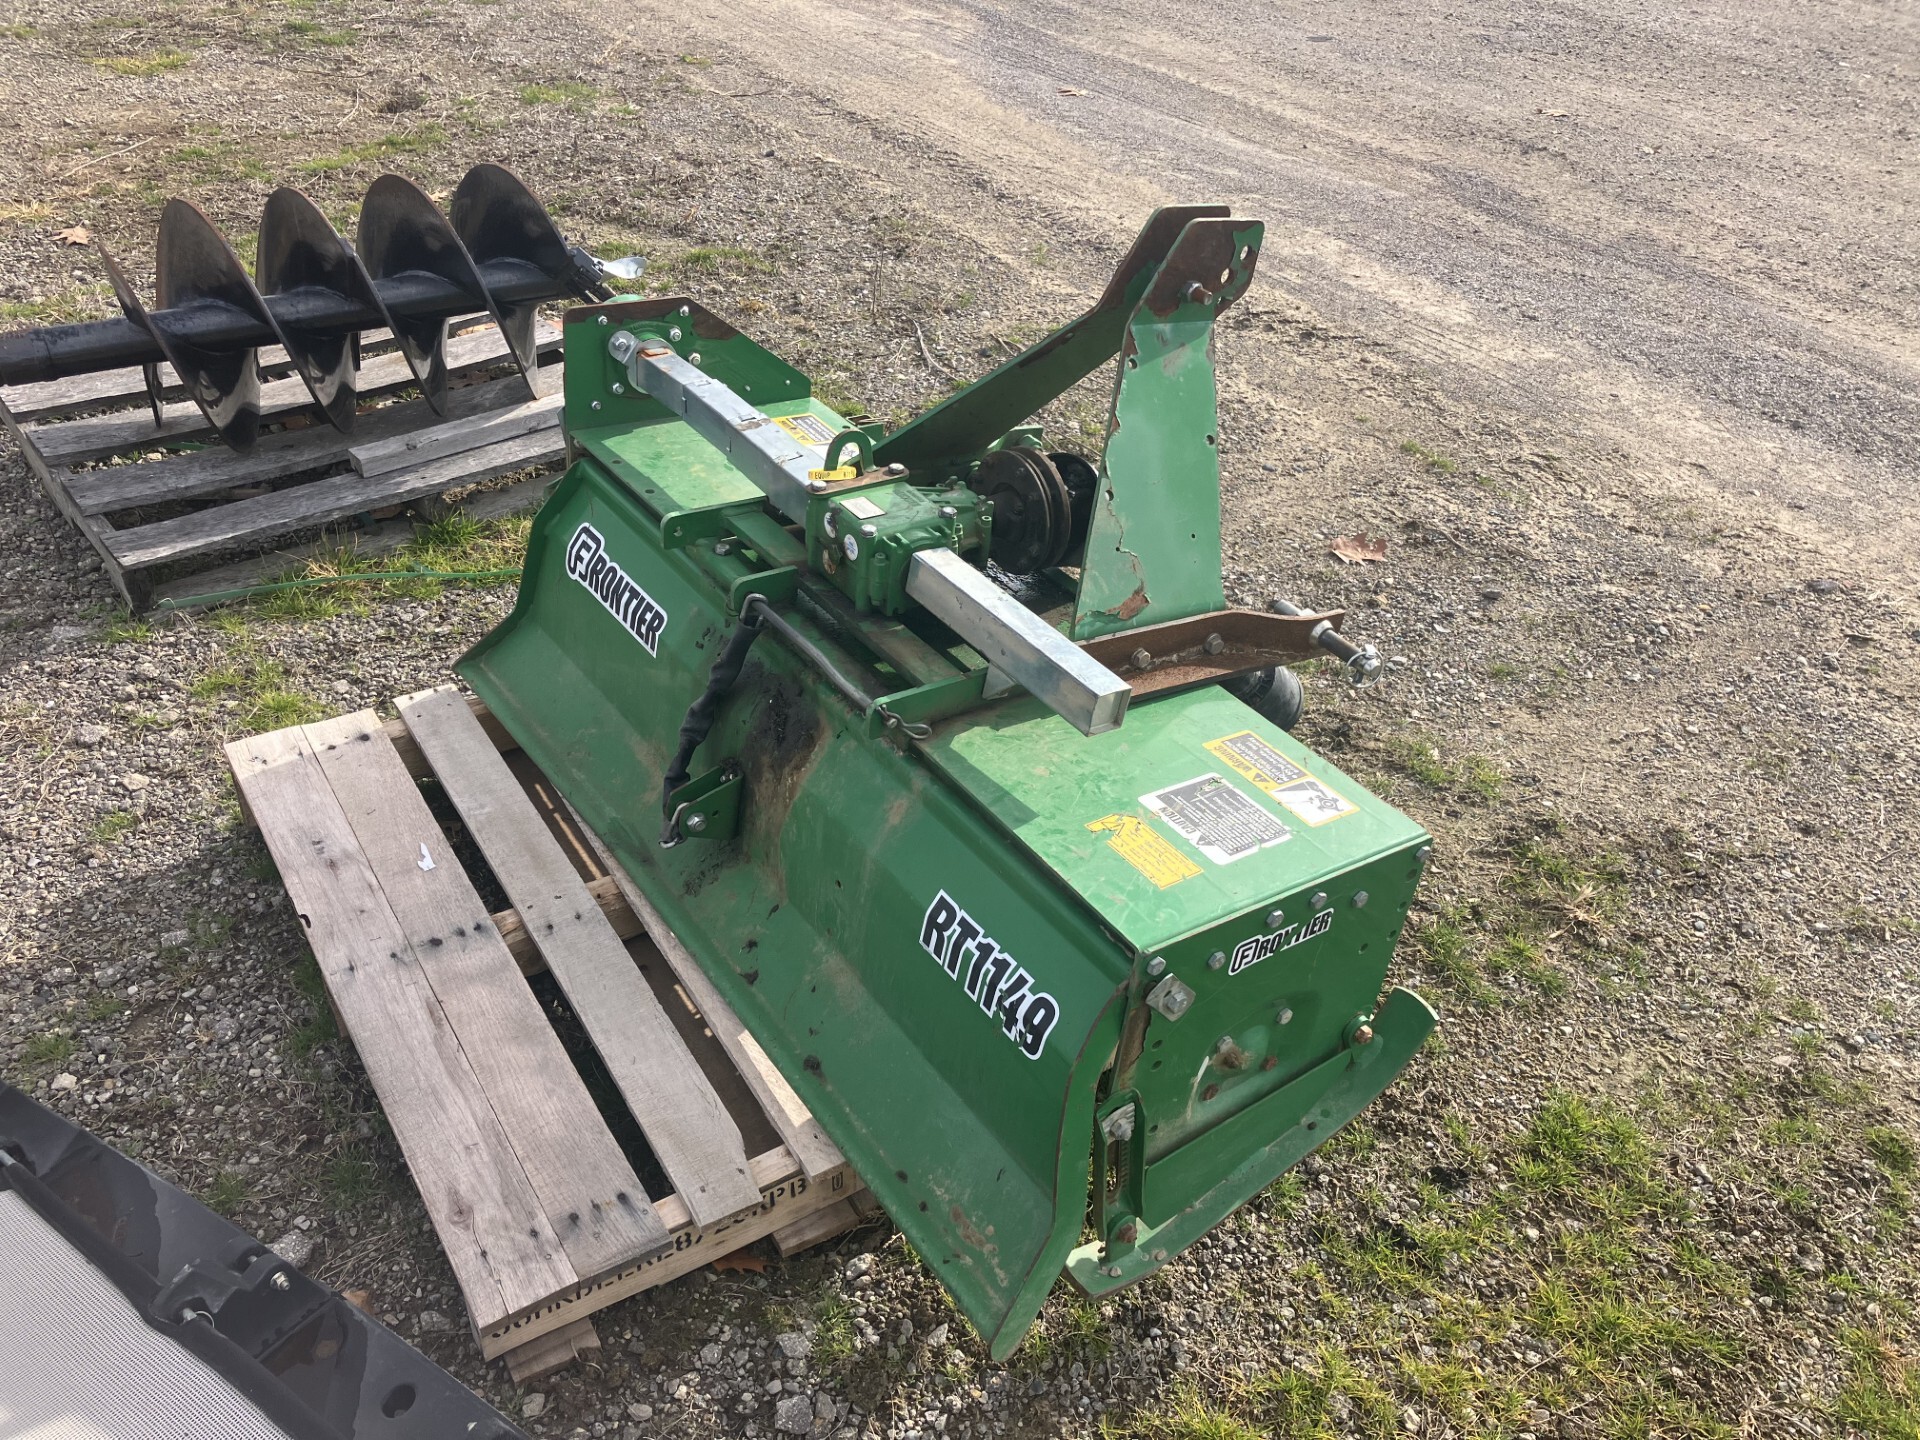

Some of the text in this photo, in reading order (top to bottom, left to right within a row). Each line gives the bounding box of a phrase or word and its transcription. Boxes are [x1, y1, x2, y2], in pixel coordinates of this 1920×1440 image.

[567, 525, 666, 653] FRONTIER
[1159, 806, 1197, 834] CAUTION
[921, 894, 1057, 1057] RT1149
